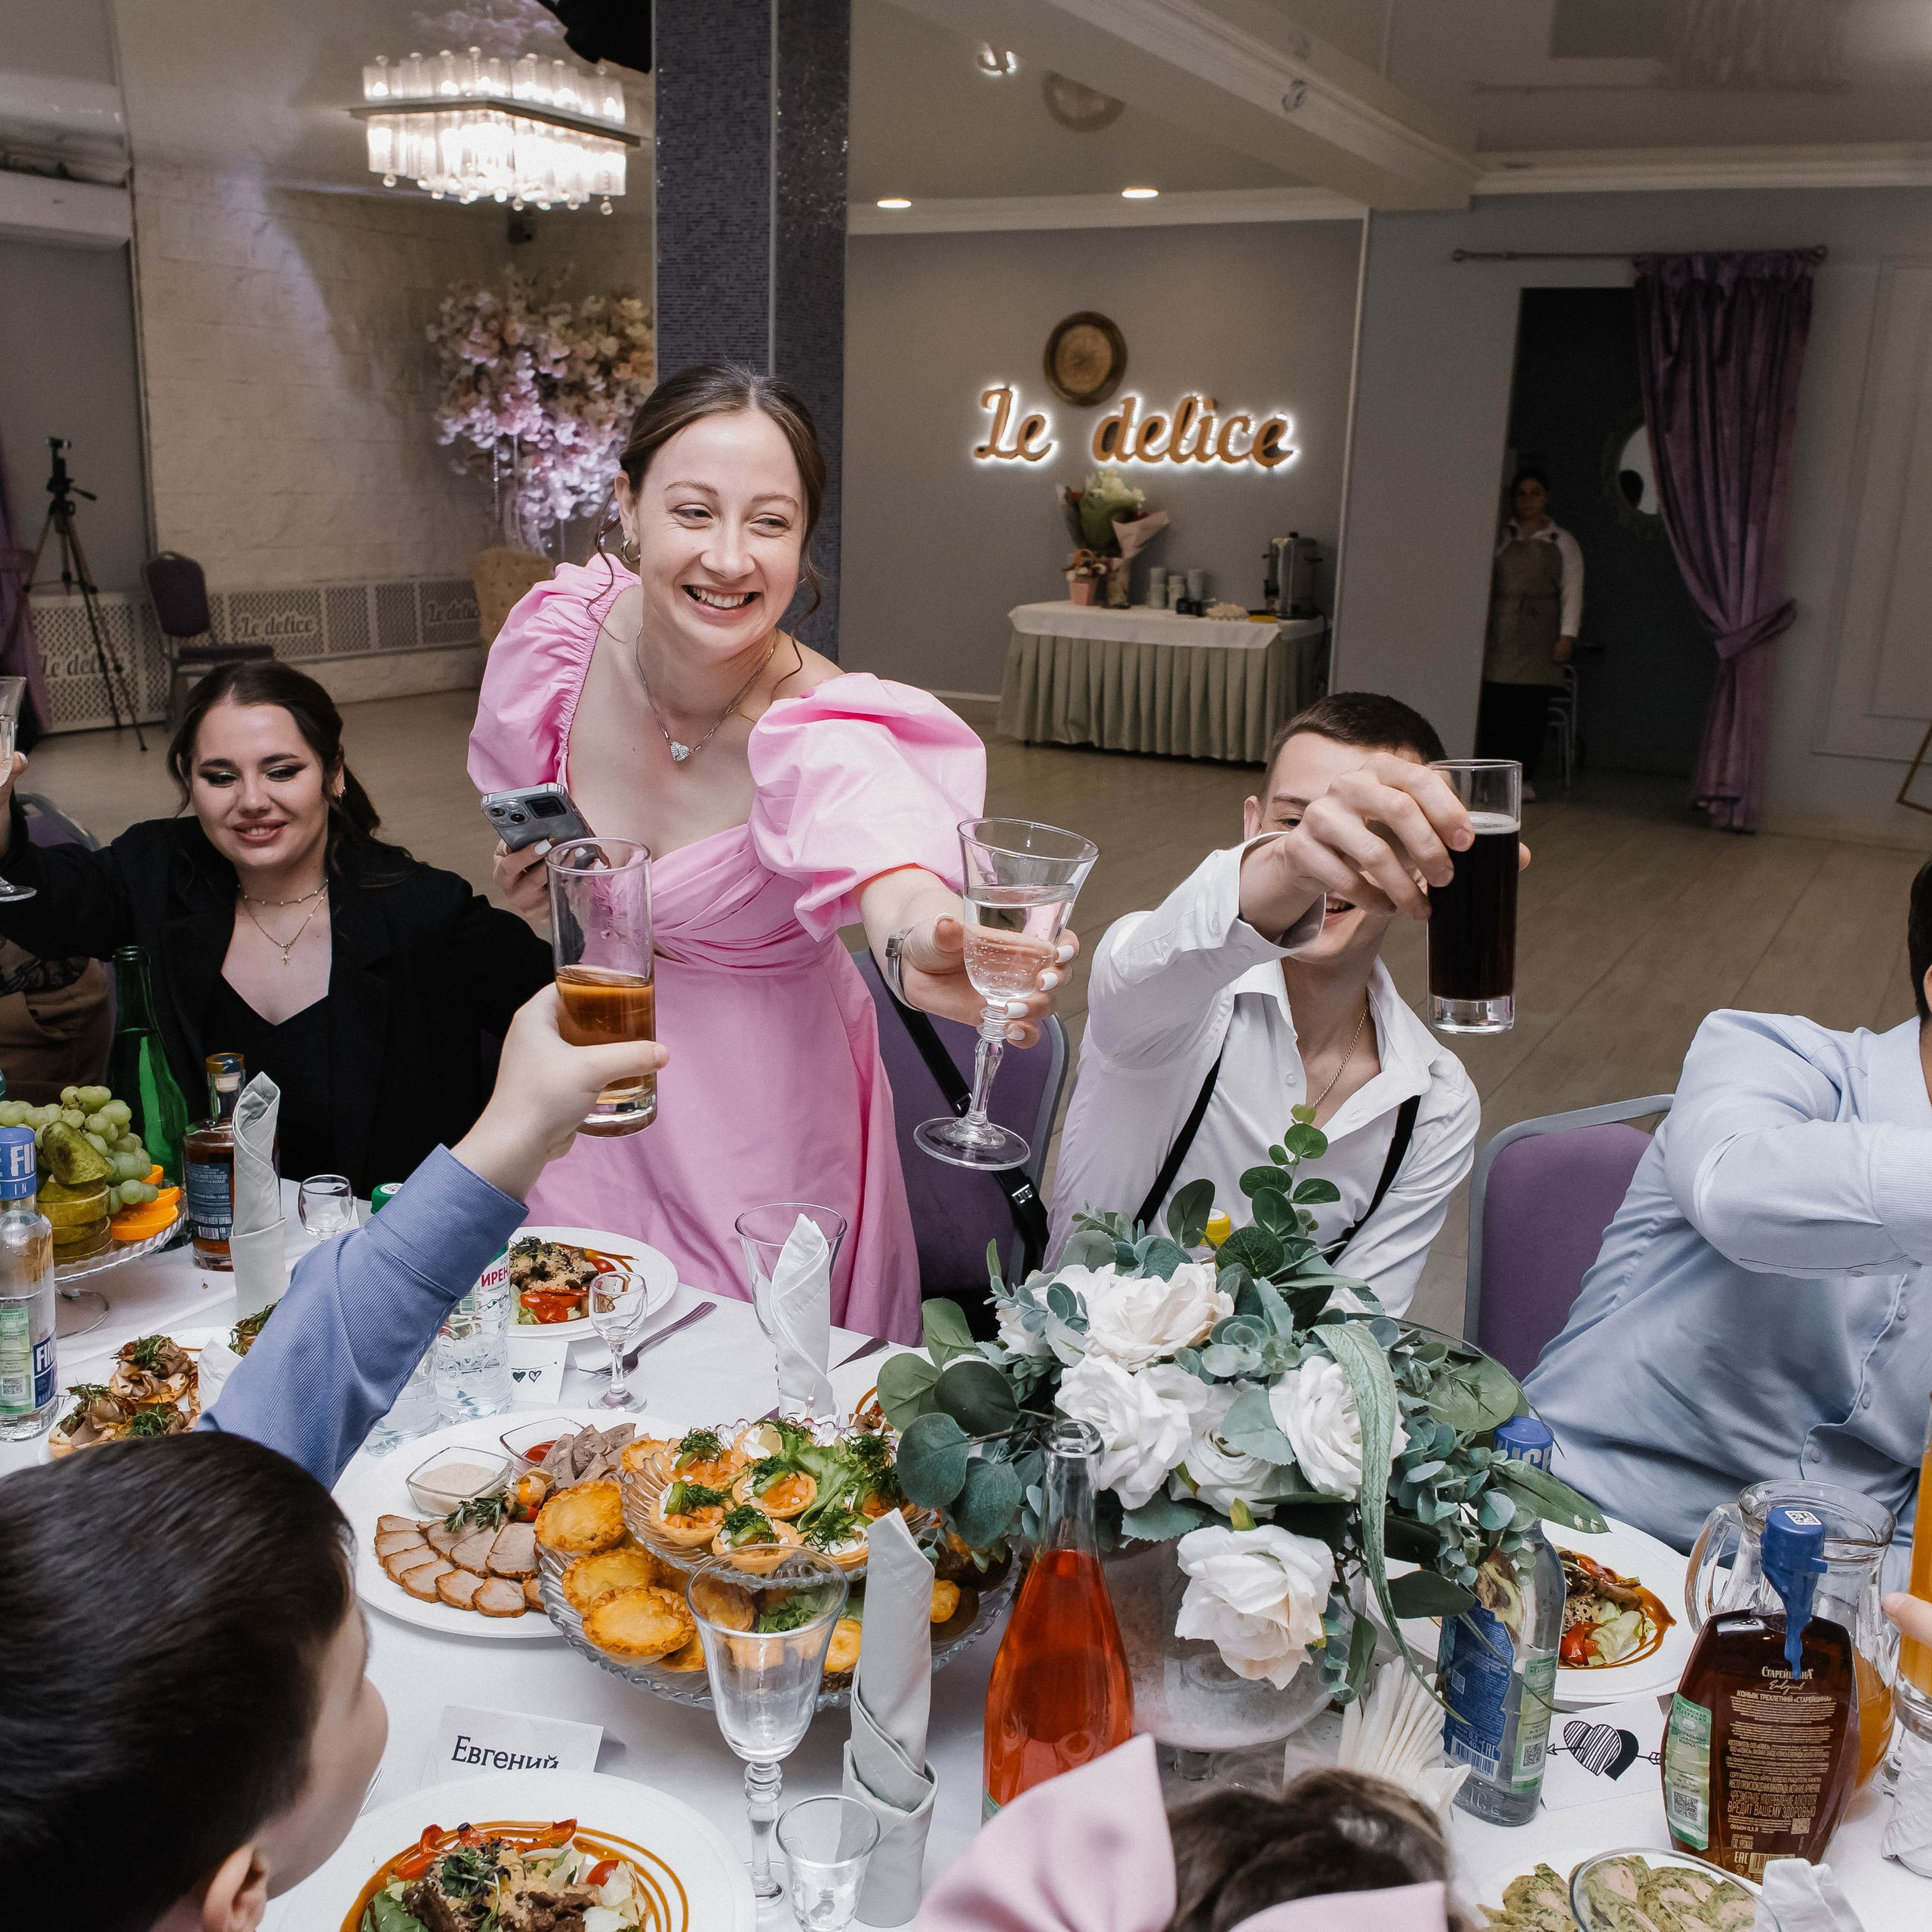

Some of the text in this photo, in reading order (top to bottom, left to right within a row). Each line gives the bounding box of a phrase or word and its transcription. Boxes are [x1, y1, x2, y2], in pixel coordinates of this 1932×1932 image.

[974, 385, 1299, 469] Le delice
[238, 614, 314, 638] Le delice
[1737, 1690, 1759, 1700] КОНЬЯК
[451, 1735, 559, 1770] Евгений
[1727, 1801, 1817, 1820] ВРЕДИТ ВАШЕМУ ЗДОРОВЬЮ
